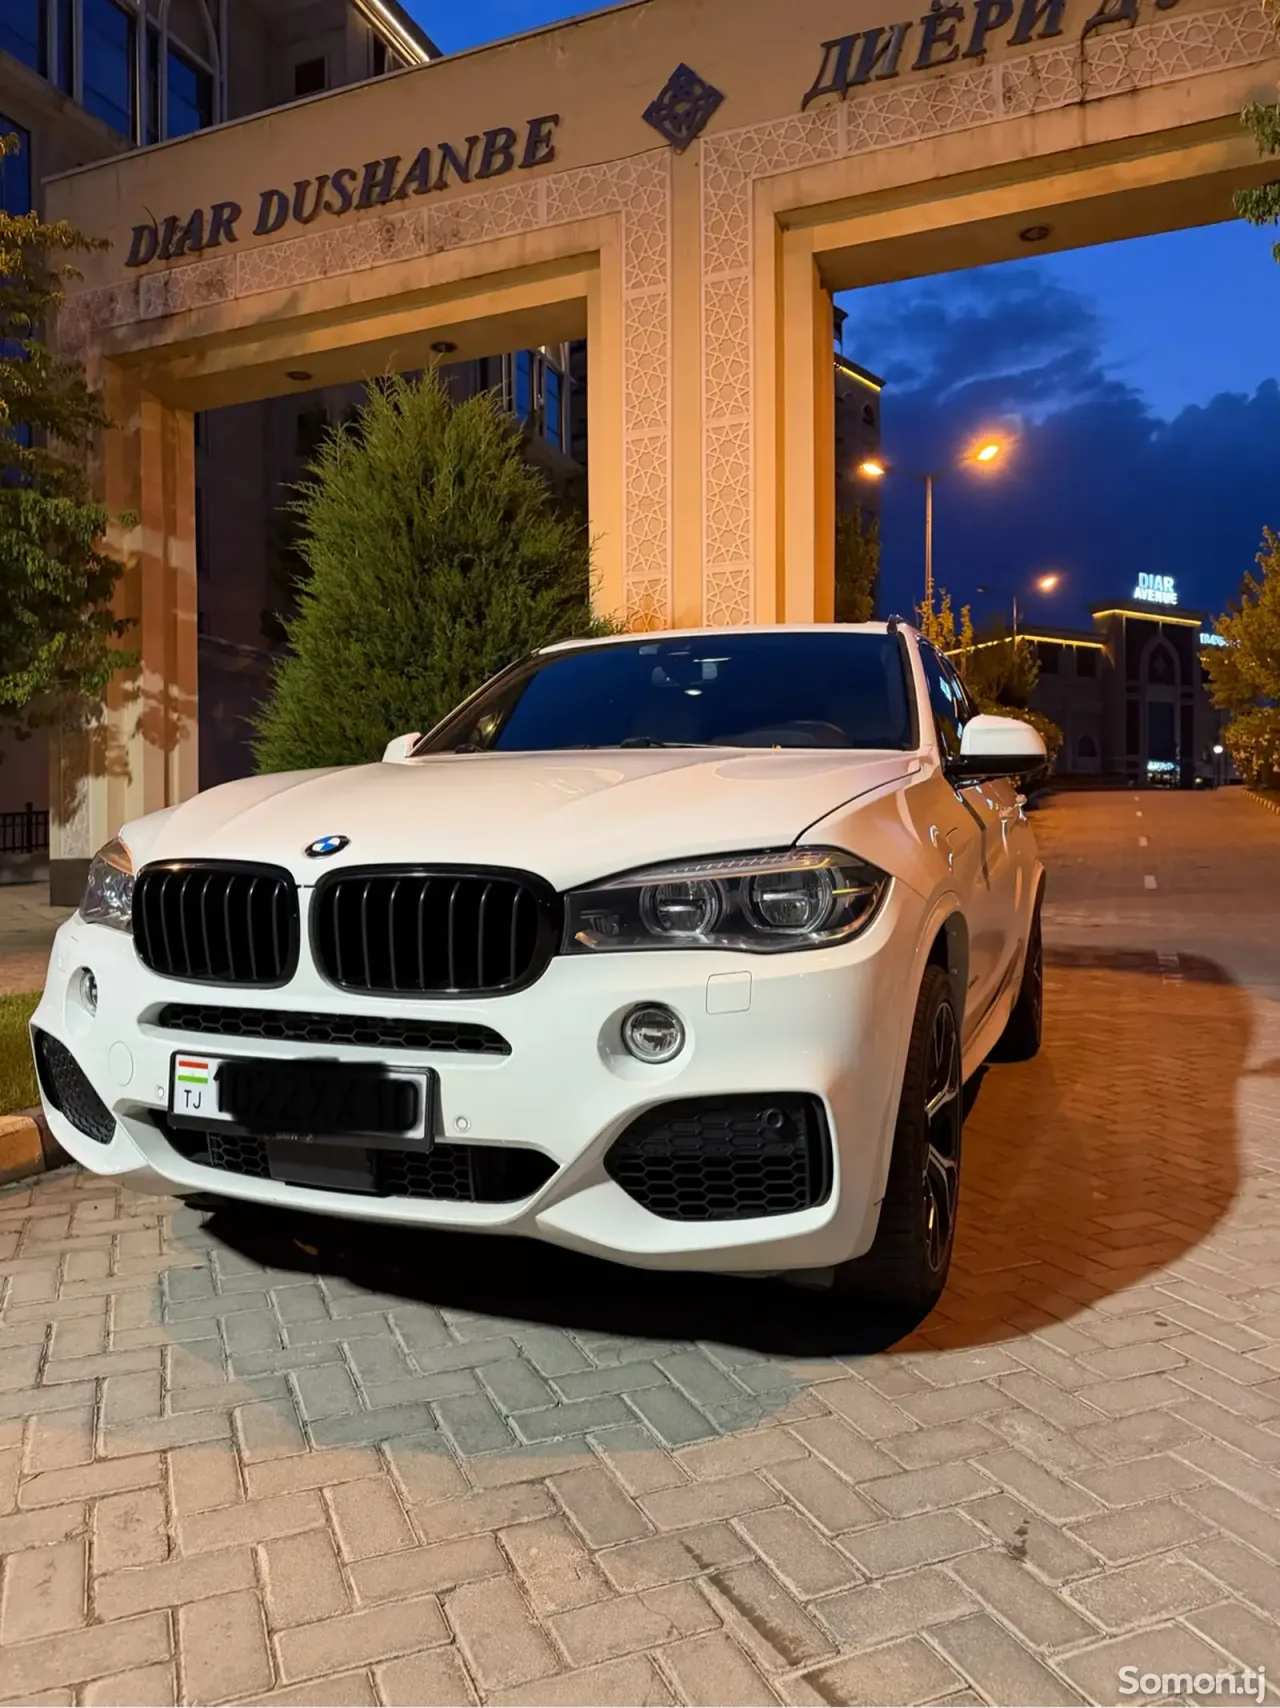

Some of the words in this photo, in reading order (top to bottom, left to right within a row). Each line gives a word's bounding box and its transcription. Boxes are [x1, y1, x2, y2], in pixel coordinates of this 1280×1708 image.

[801, 0, 1066, 112] ДИЁРИ
[125, 201, 242, 267] DIAR
[253, 113, 561, 236] DUSHANBE
[1138, 572, 1175, 593] DIAR
[1133, 586, 1178, 605] AVENUE
[183, 1089, 202, 1110] TJ
